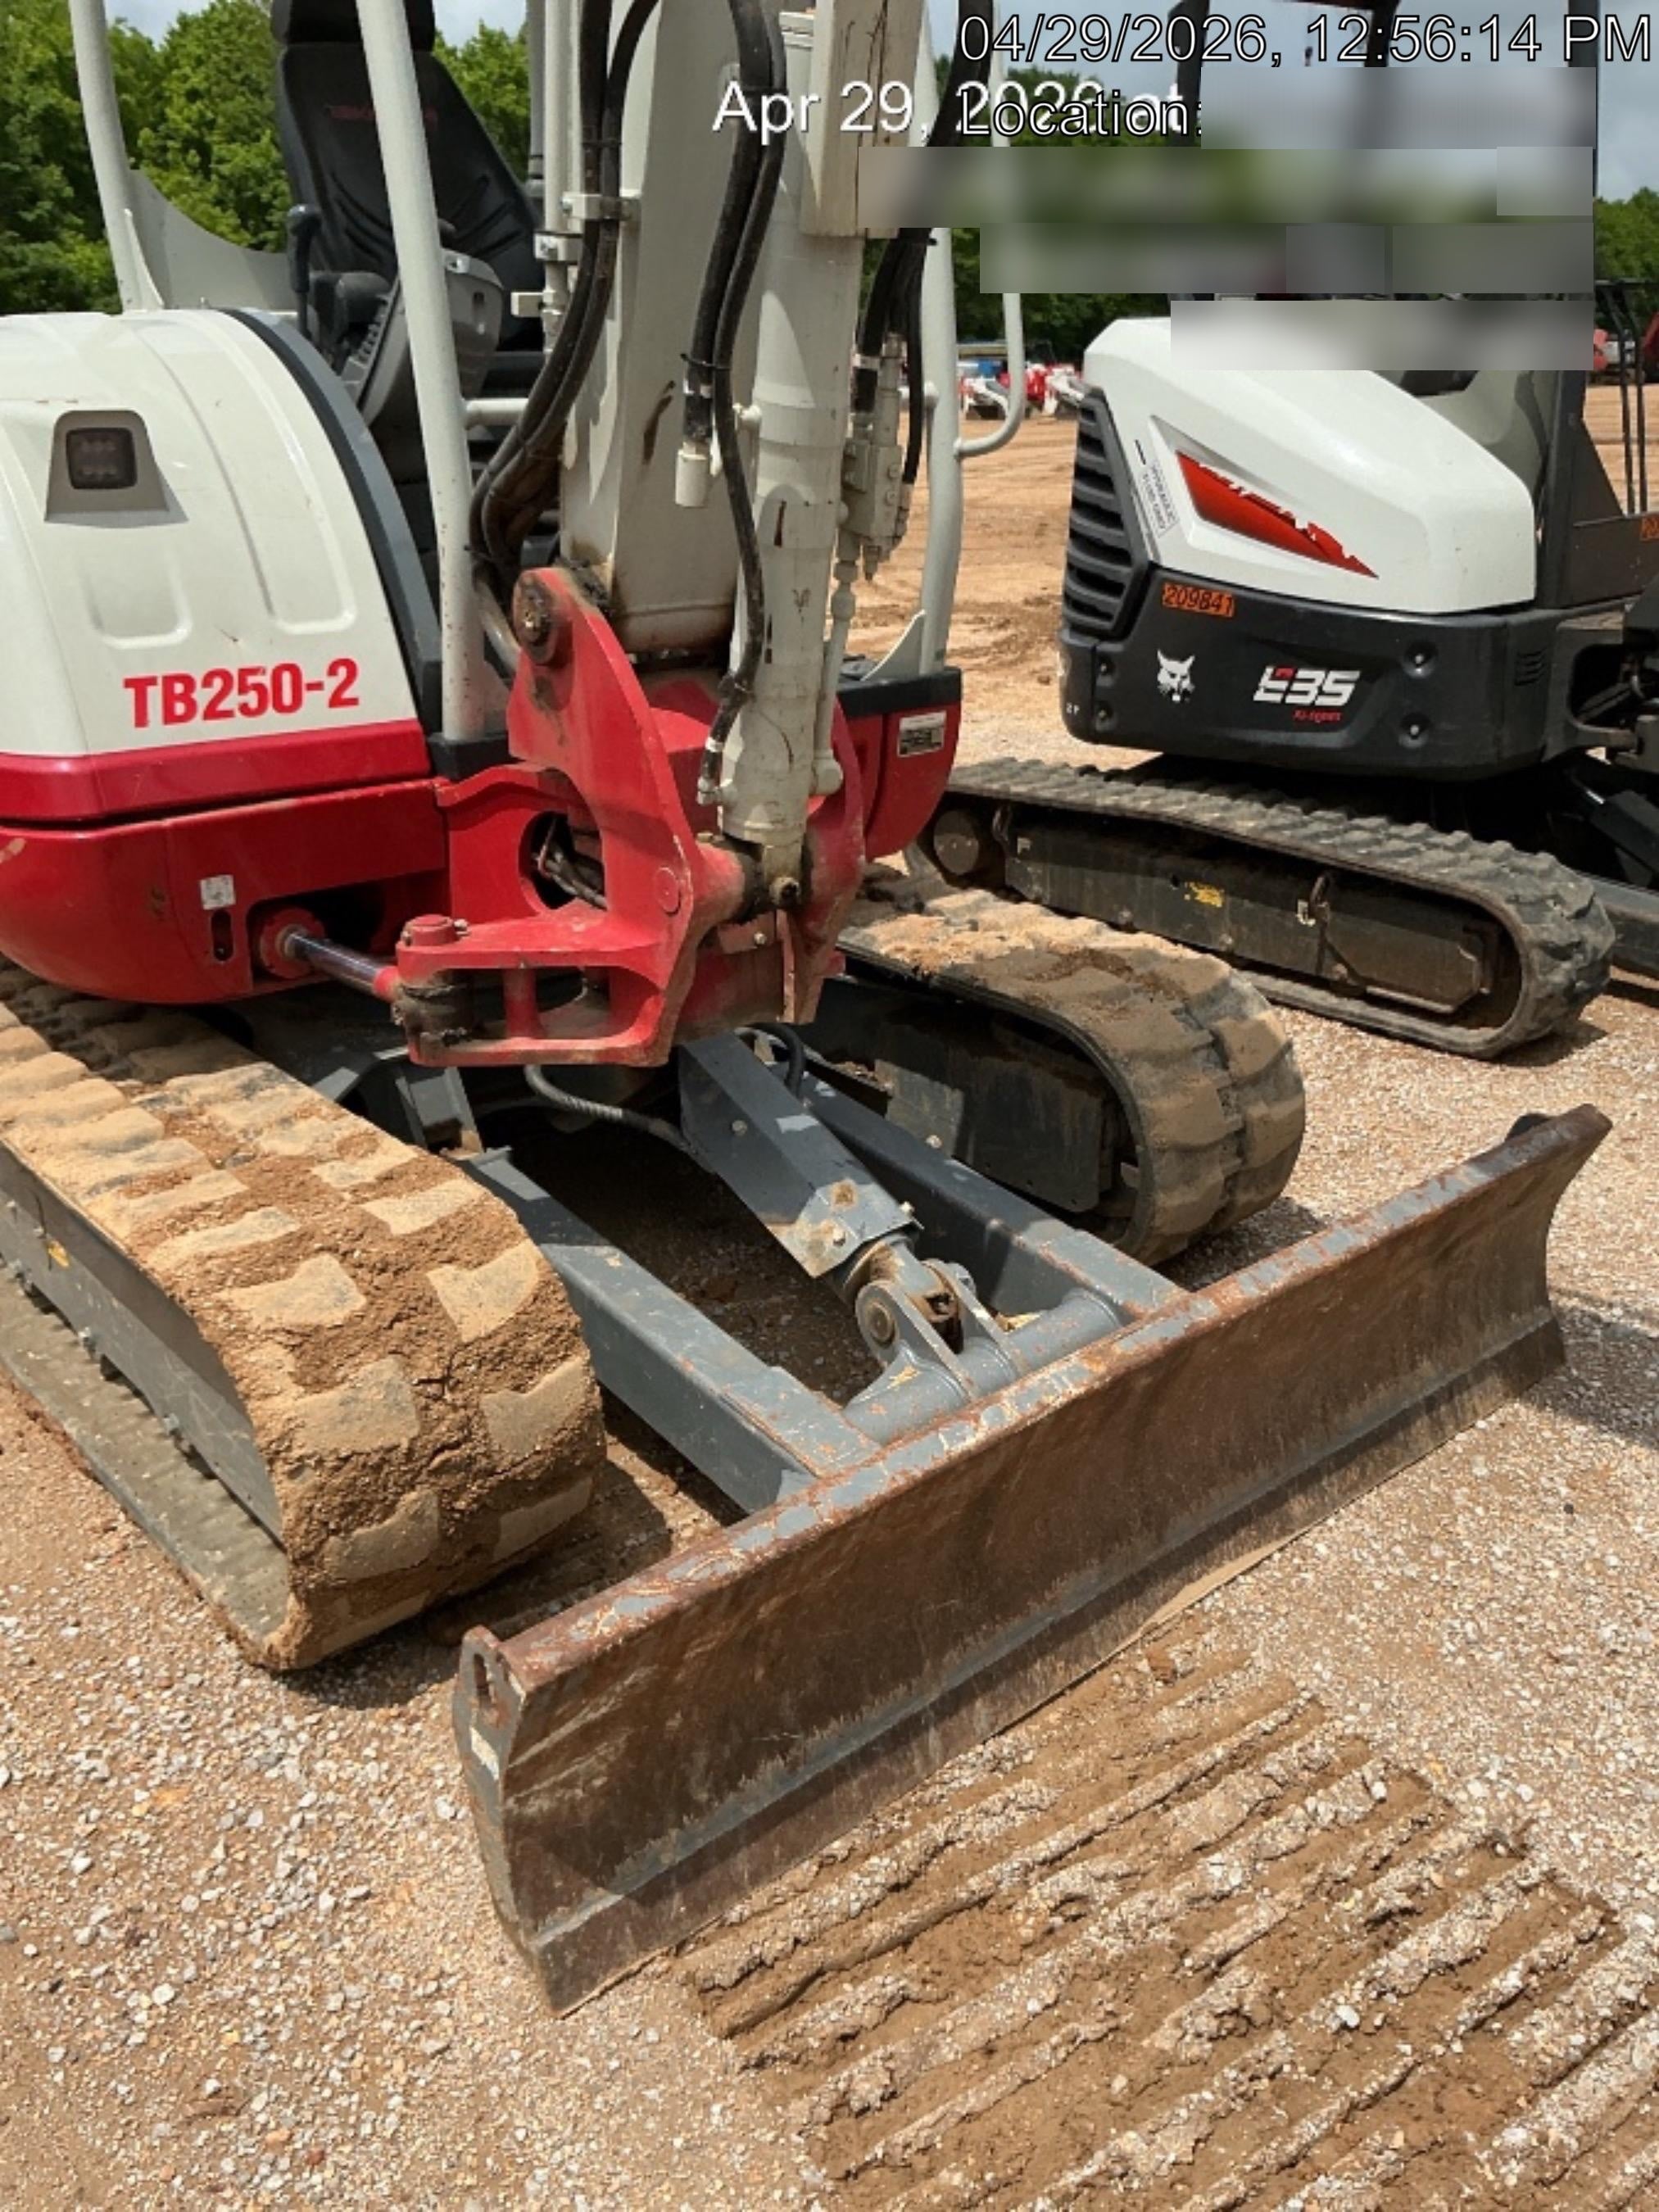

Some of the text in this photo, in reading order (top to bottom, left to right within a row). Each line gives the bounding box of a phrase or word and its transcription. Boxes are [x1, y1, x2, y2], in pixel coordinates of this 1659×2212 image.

[1164, 584, 1233, 614] 209841
[123, 658, 360, 728] TB250-2
[1253, 665, 1361, 707] E35
